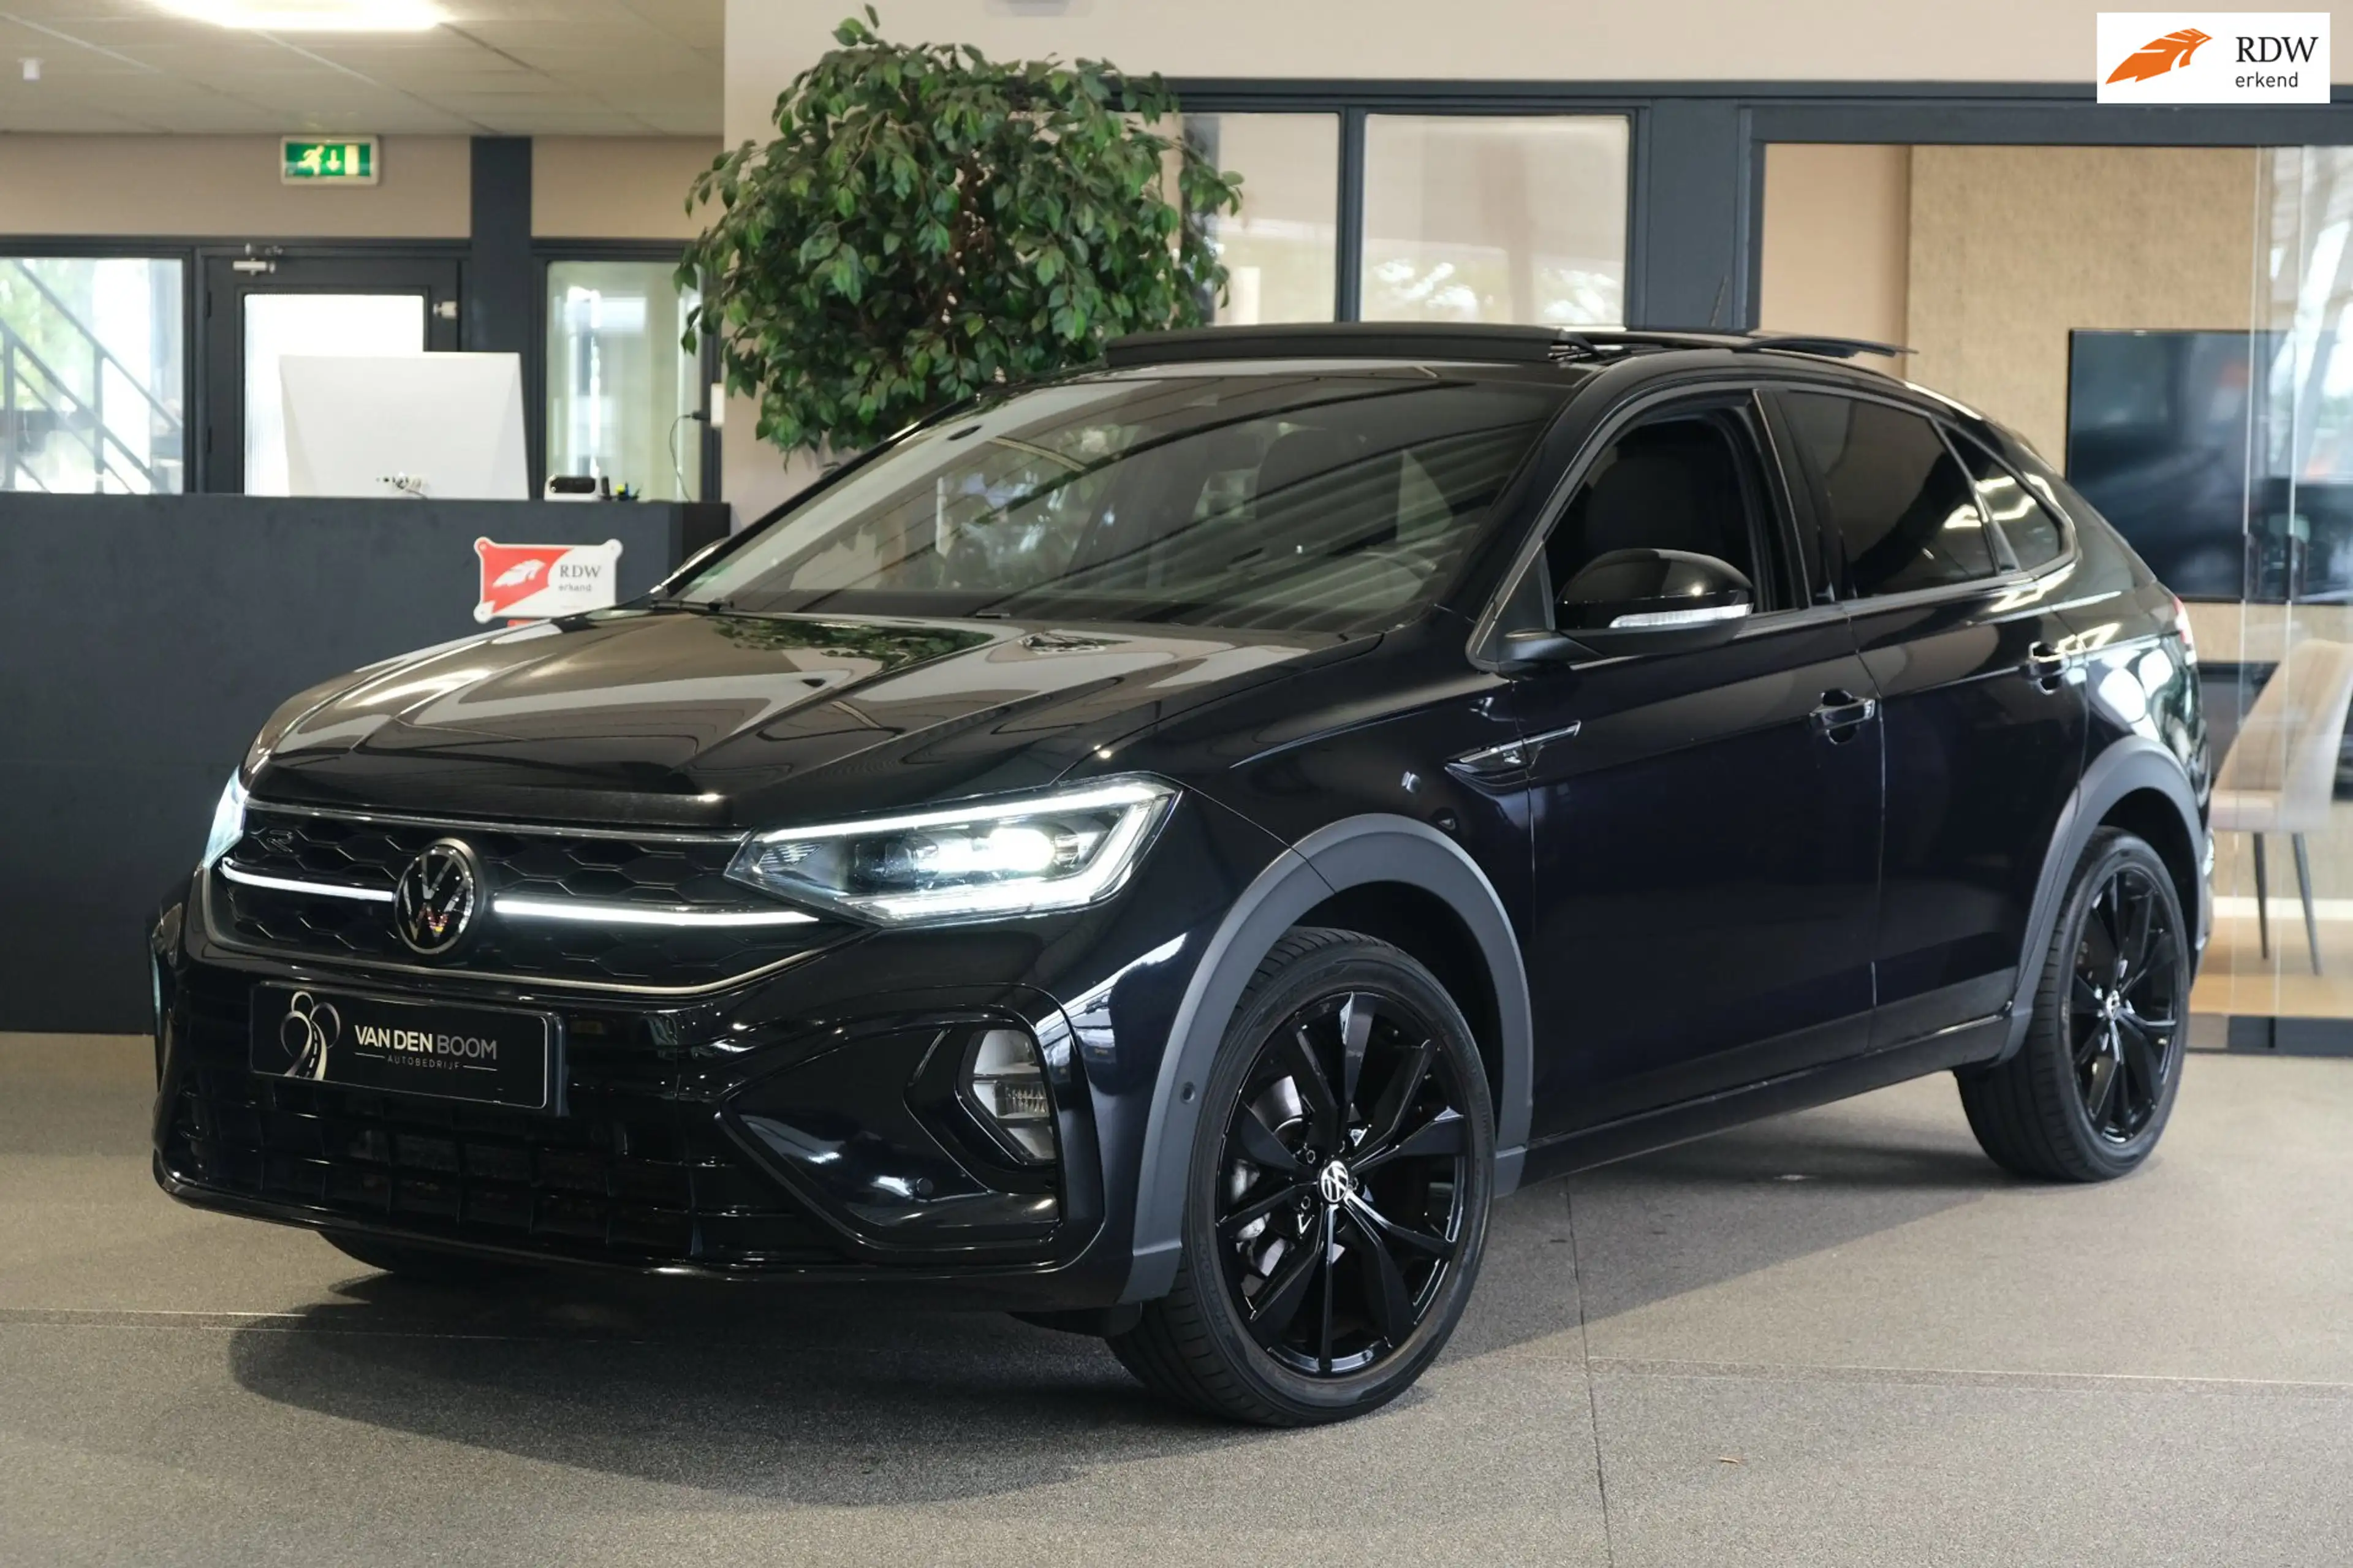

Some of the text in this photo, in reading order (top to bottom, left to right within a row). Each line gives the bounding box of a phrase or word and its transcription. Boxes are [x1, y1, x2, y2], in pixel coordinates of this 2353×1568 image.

[559, 564, 602, 578] RDW
[354, 1025, 498, 1060] VAN DEN BOOM
[387, 1055, 461, 1070] AUTOBEDRIJF
